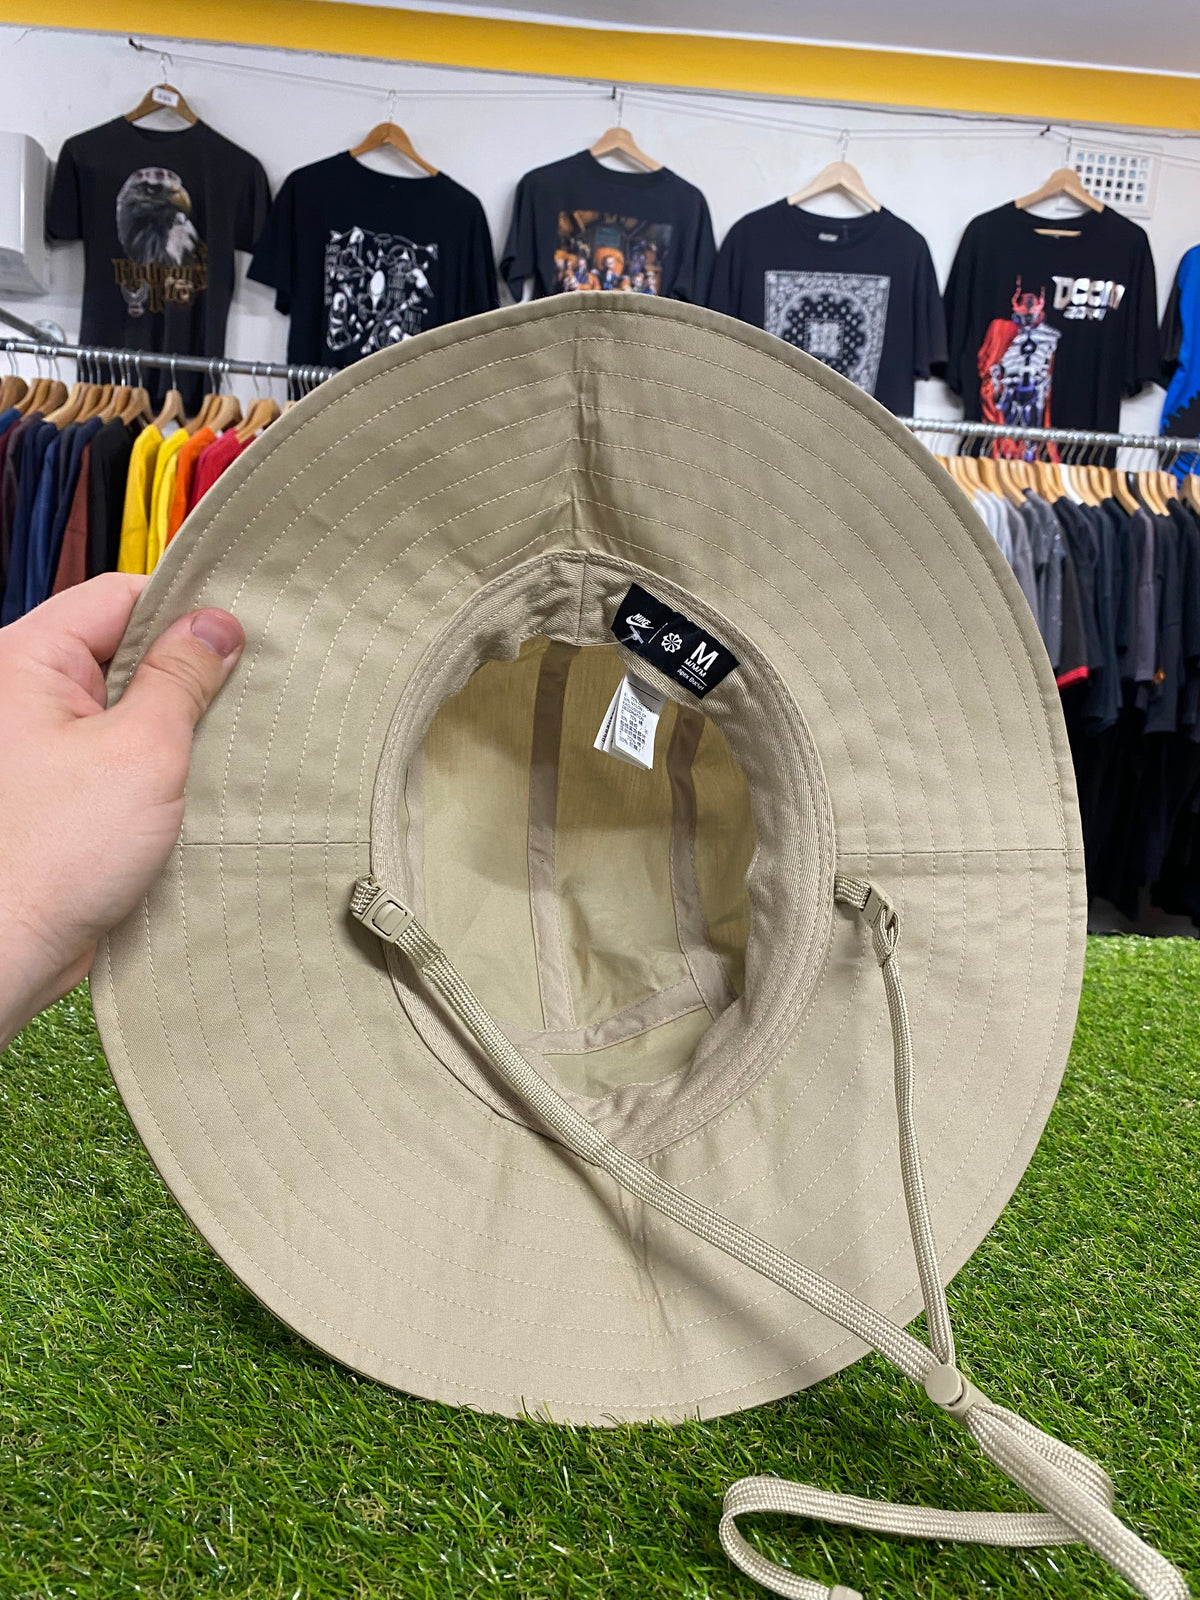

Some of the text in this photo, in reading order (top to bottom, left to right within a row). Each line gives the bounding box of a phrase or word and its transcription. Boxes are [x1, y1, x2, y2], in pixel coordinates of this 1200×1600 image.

[632, 613, 652, 626] NIKE
[690, 641, 719, 671] M
[683, 658, 707, 678] M/M/M
